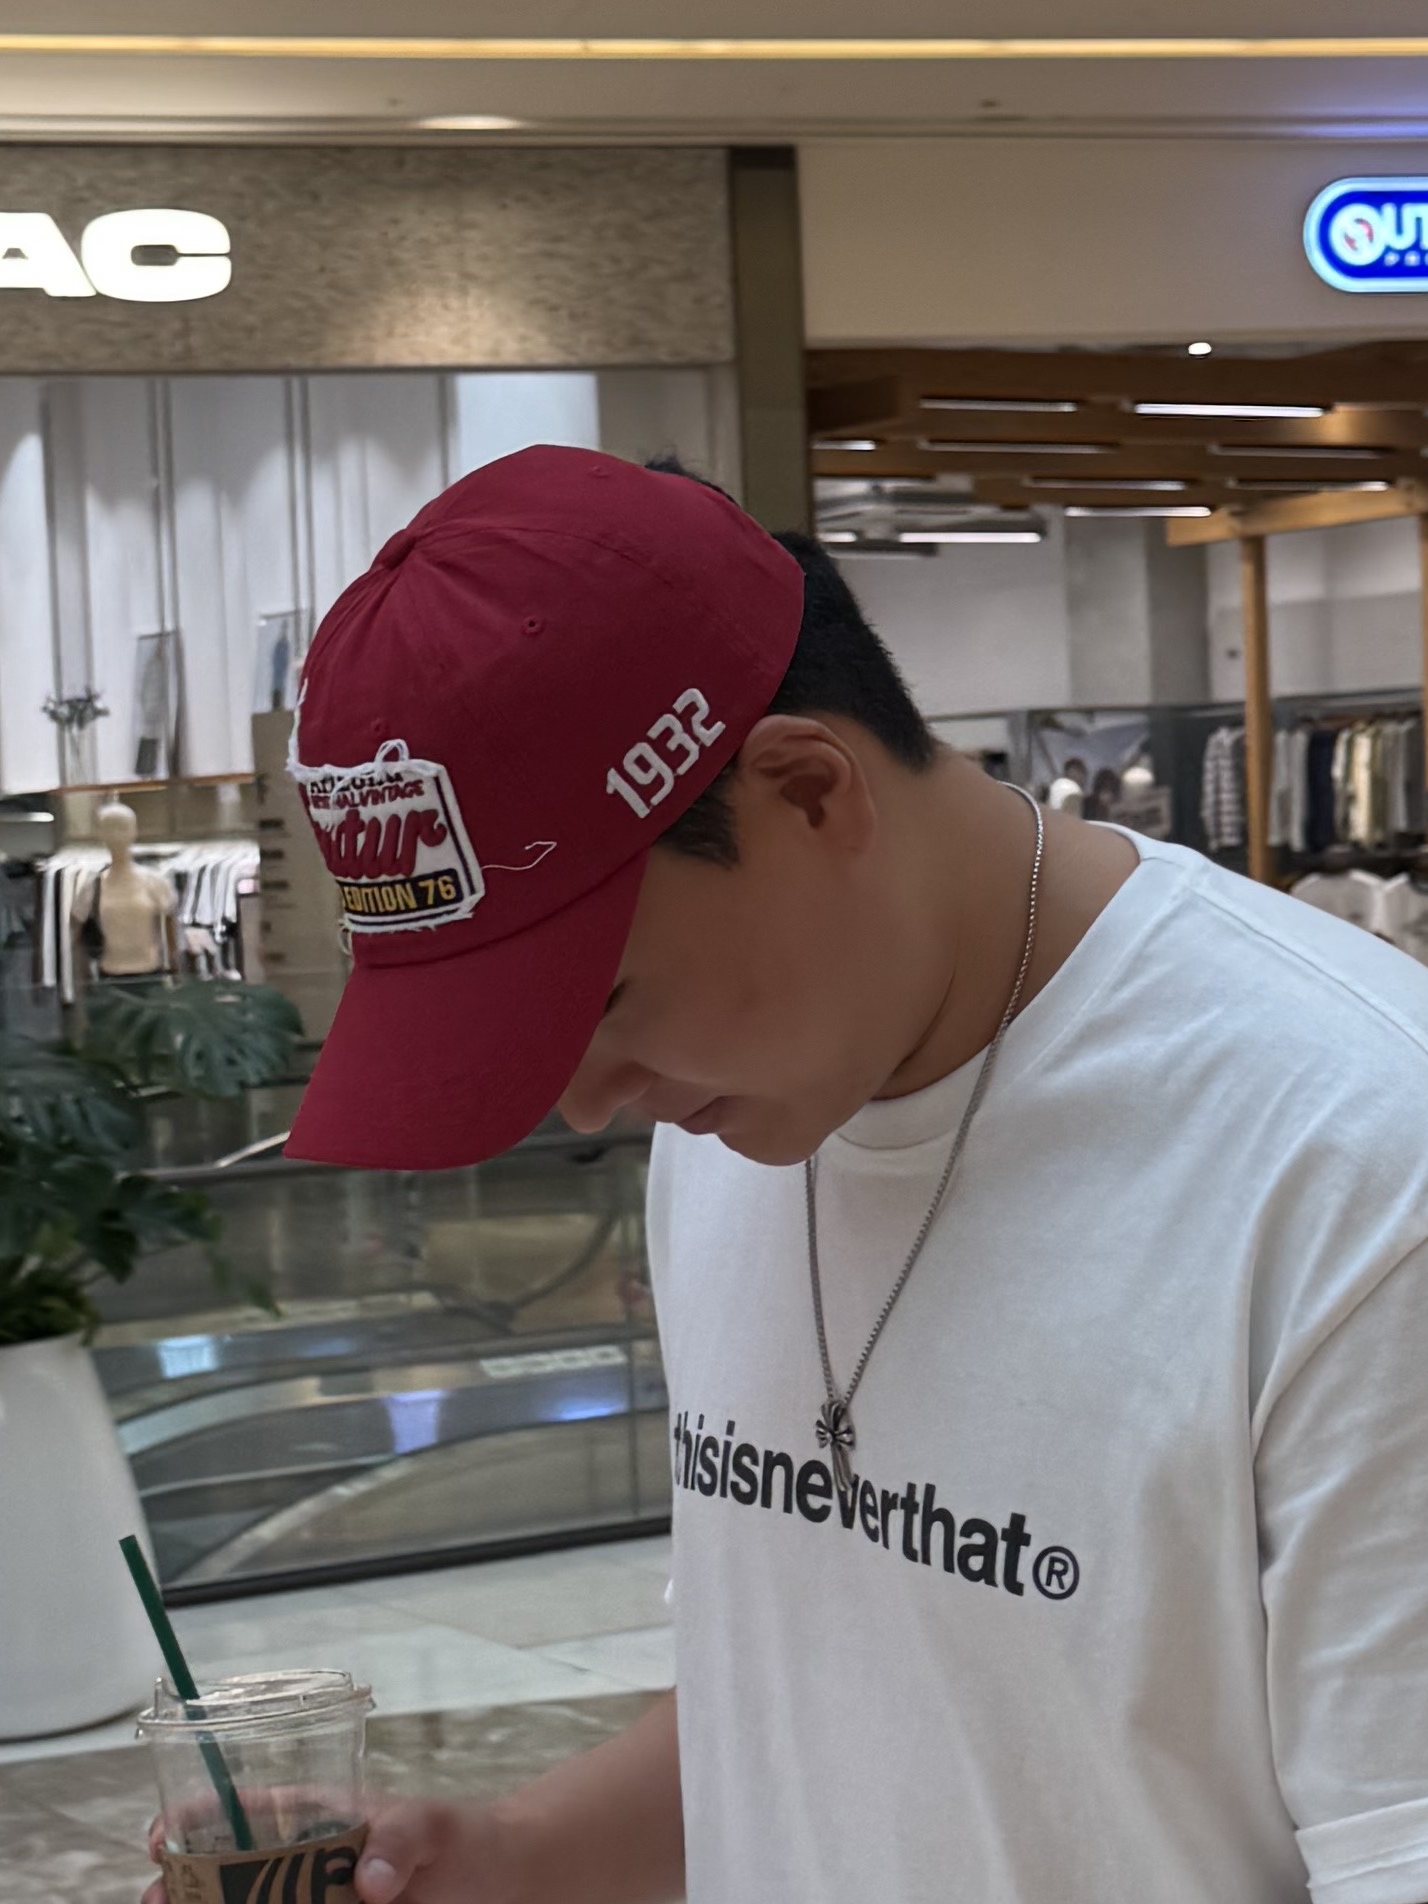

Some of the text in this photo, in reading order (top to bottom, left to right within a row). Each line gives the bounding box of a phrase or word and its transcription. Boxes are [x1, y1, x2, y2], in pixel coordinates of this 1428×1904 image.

[606, 687, 727, 819] 1932
[343, 874, 458, 914] EDITION 76
